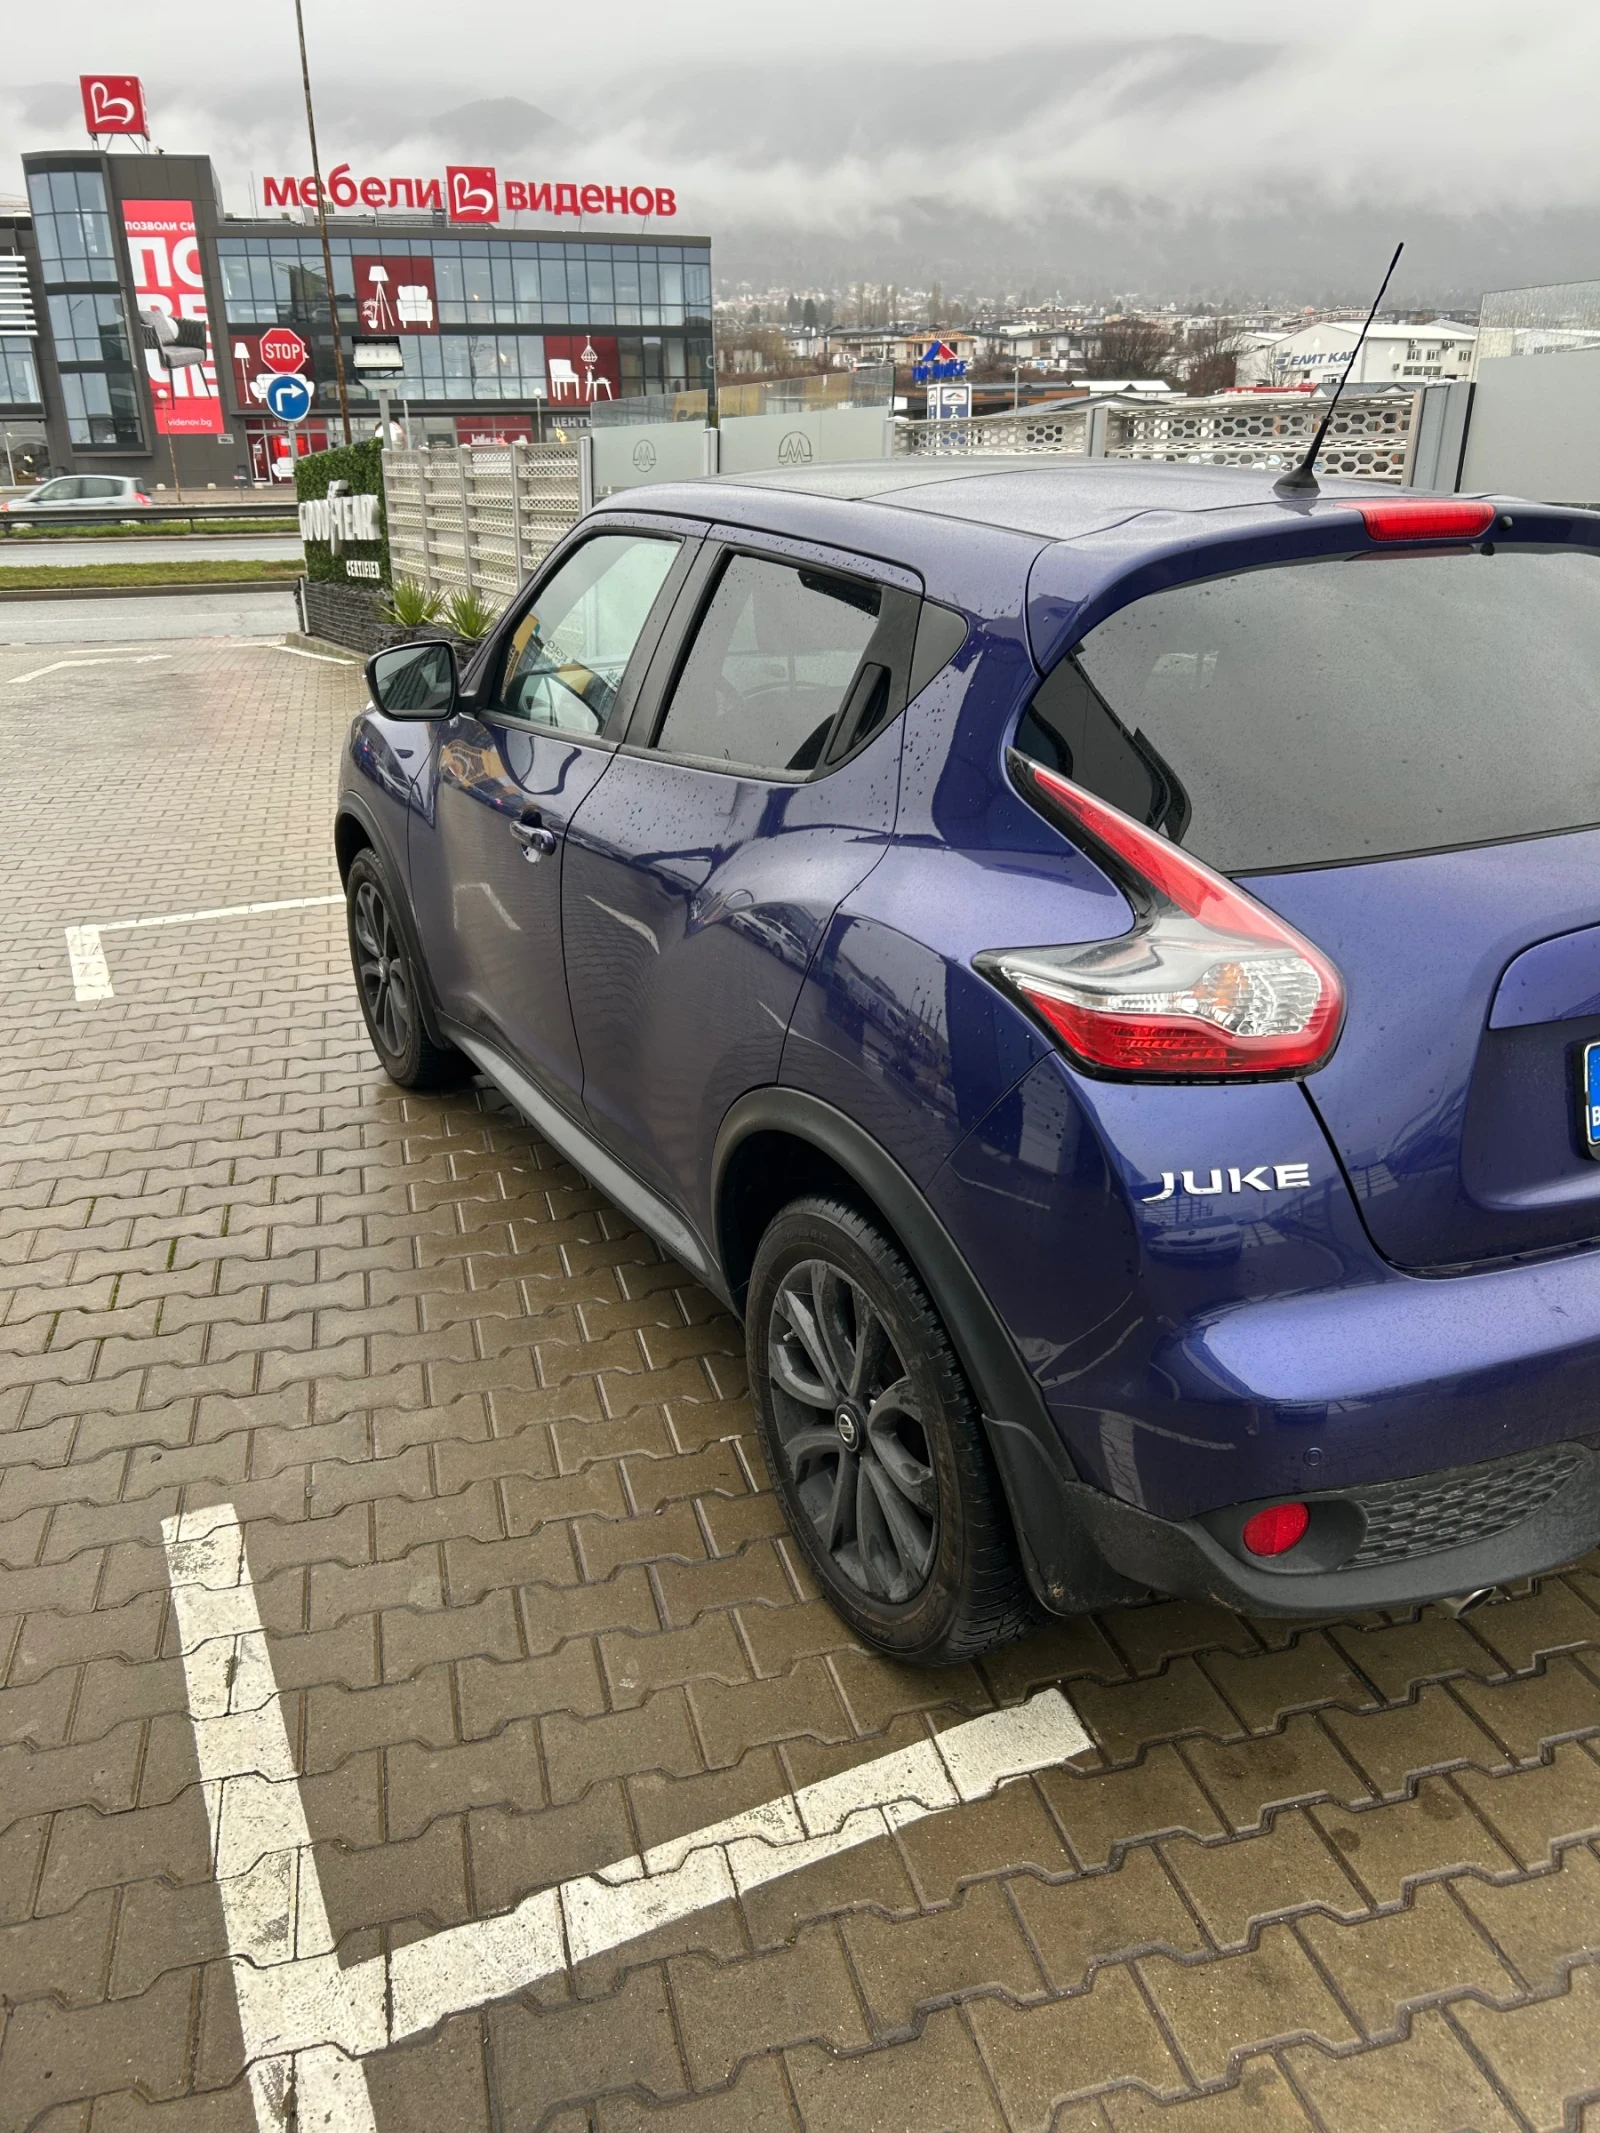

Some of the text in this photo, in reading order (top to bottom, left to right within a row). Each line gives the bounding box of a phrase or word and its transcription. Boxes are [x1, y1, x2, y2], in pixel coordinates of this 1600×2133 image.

[263, 162, 677, 216] мебели виденов
[127, 236, 204, 288] ПО
[265, 343, 300, 359] STOP
[1290, 353, 1325, 366] ЕЛИТ
[167, 418, 213, 428] videnov.bg
[1141, 1163, 1311, 1204] JUKE
